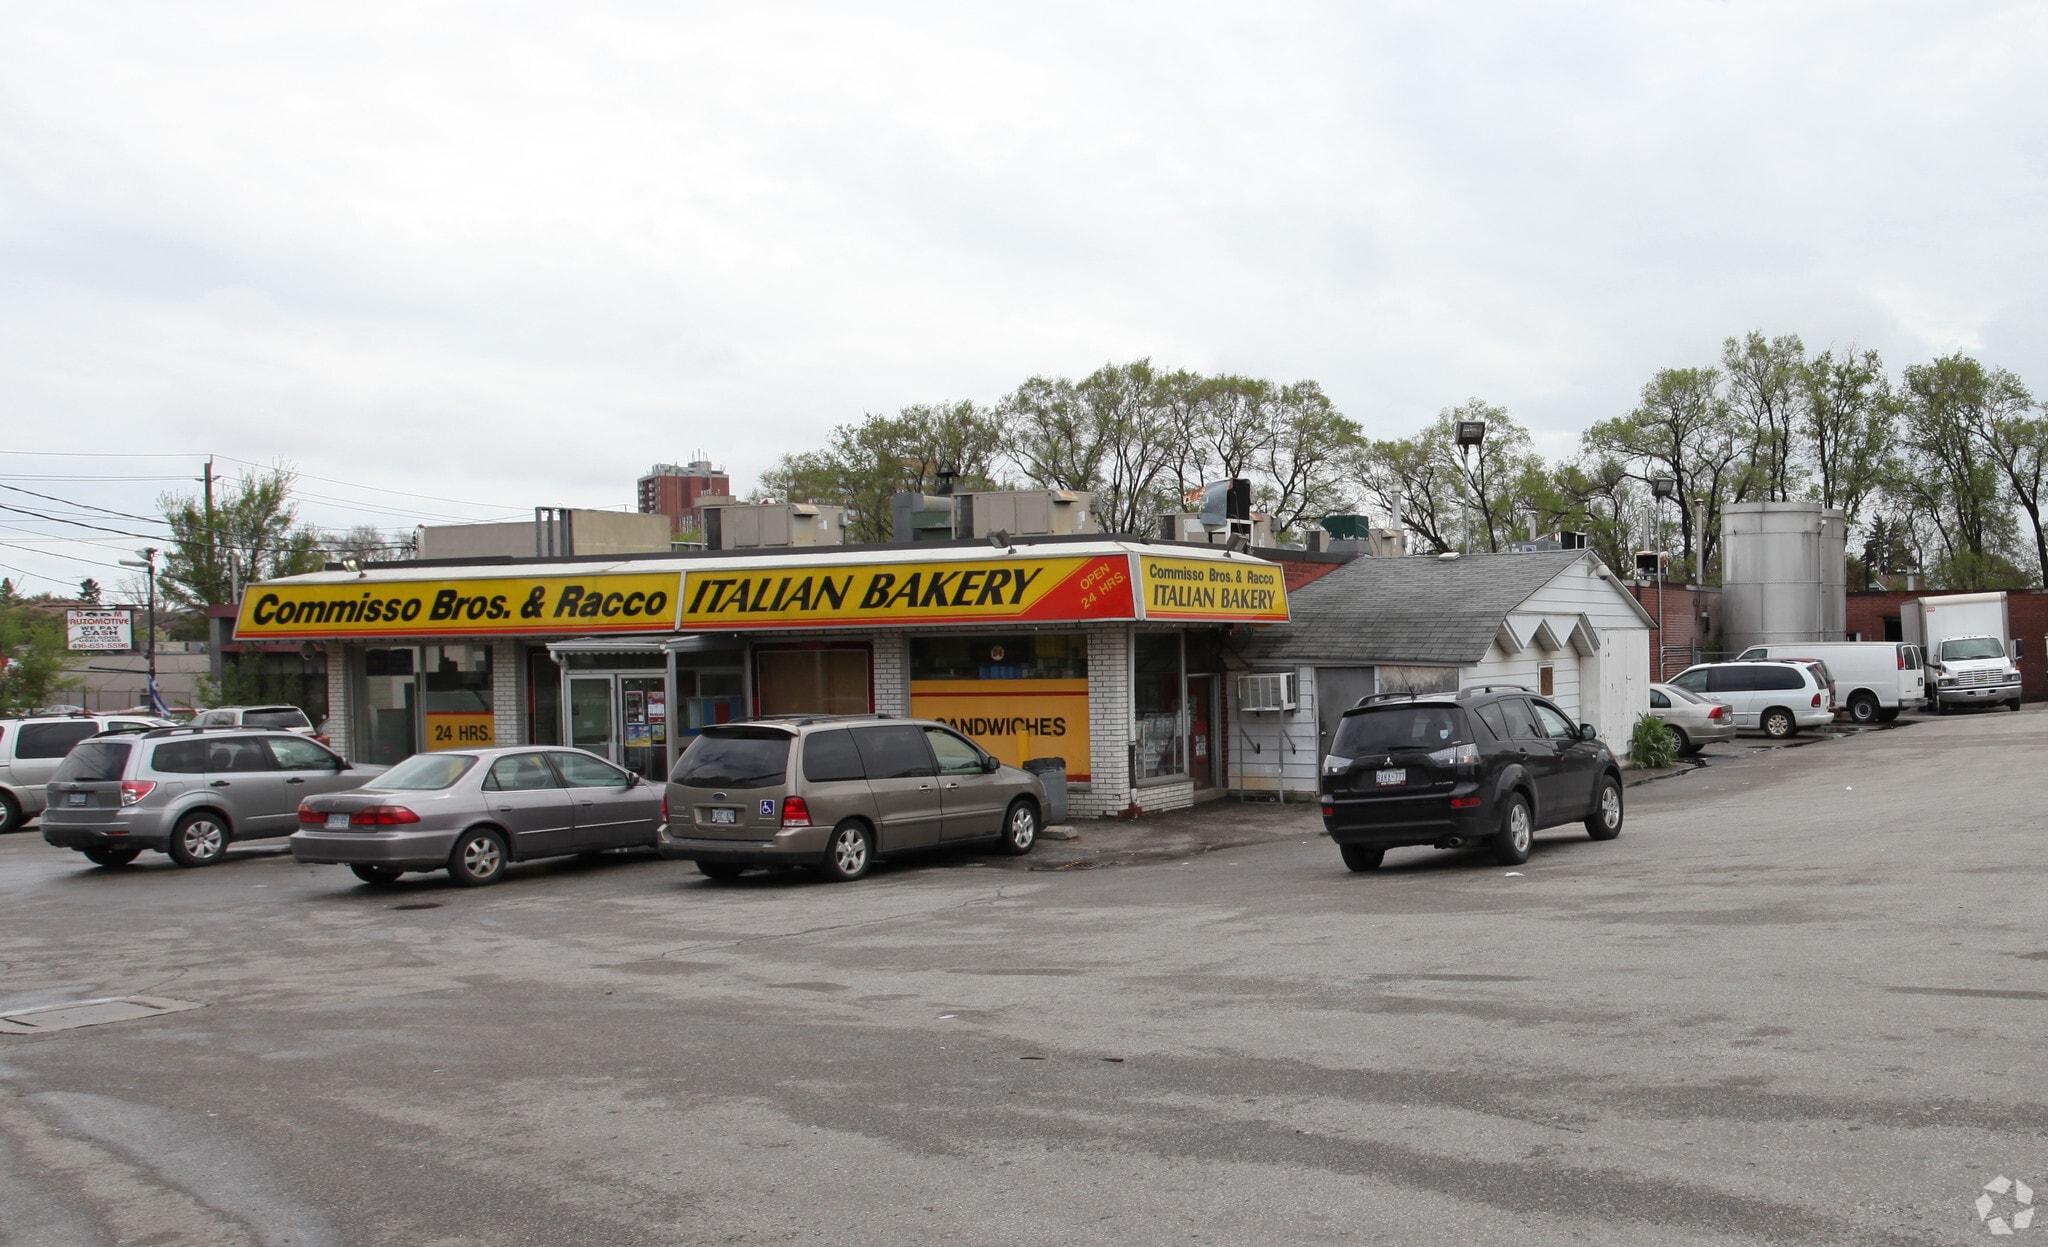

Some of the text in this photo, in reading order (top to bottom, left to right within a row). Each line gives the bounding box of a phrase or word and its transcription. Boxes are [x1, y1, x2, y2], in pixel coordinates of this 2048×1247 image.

[1080, 562, 1111, 590] OPEN
[1150, 563, 1274, 585] Commisso Bros. & Racco
[687, 567, 1044, 614] ITALIAN BAKERY
[1081, 571, 1127, 609] 24 HRS.
[1153, 584, 1276, 610] ITALIAN BAKERY
[253, 585, 667, 626] Commisso Bros. & Racco
[435, 724, 493, 741] 24 HRS.
